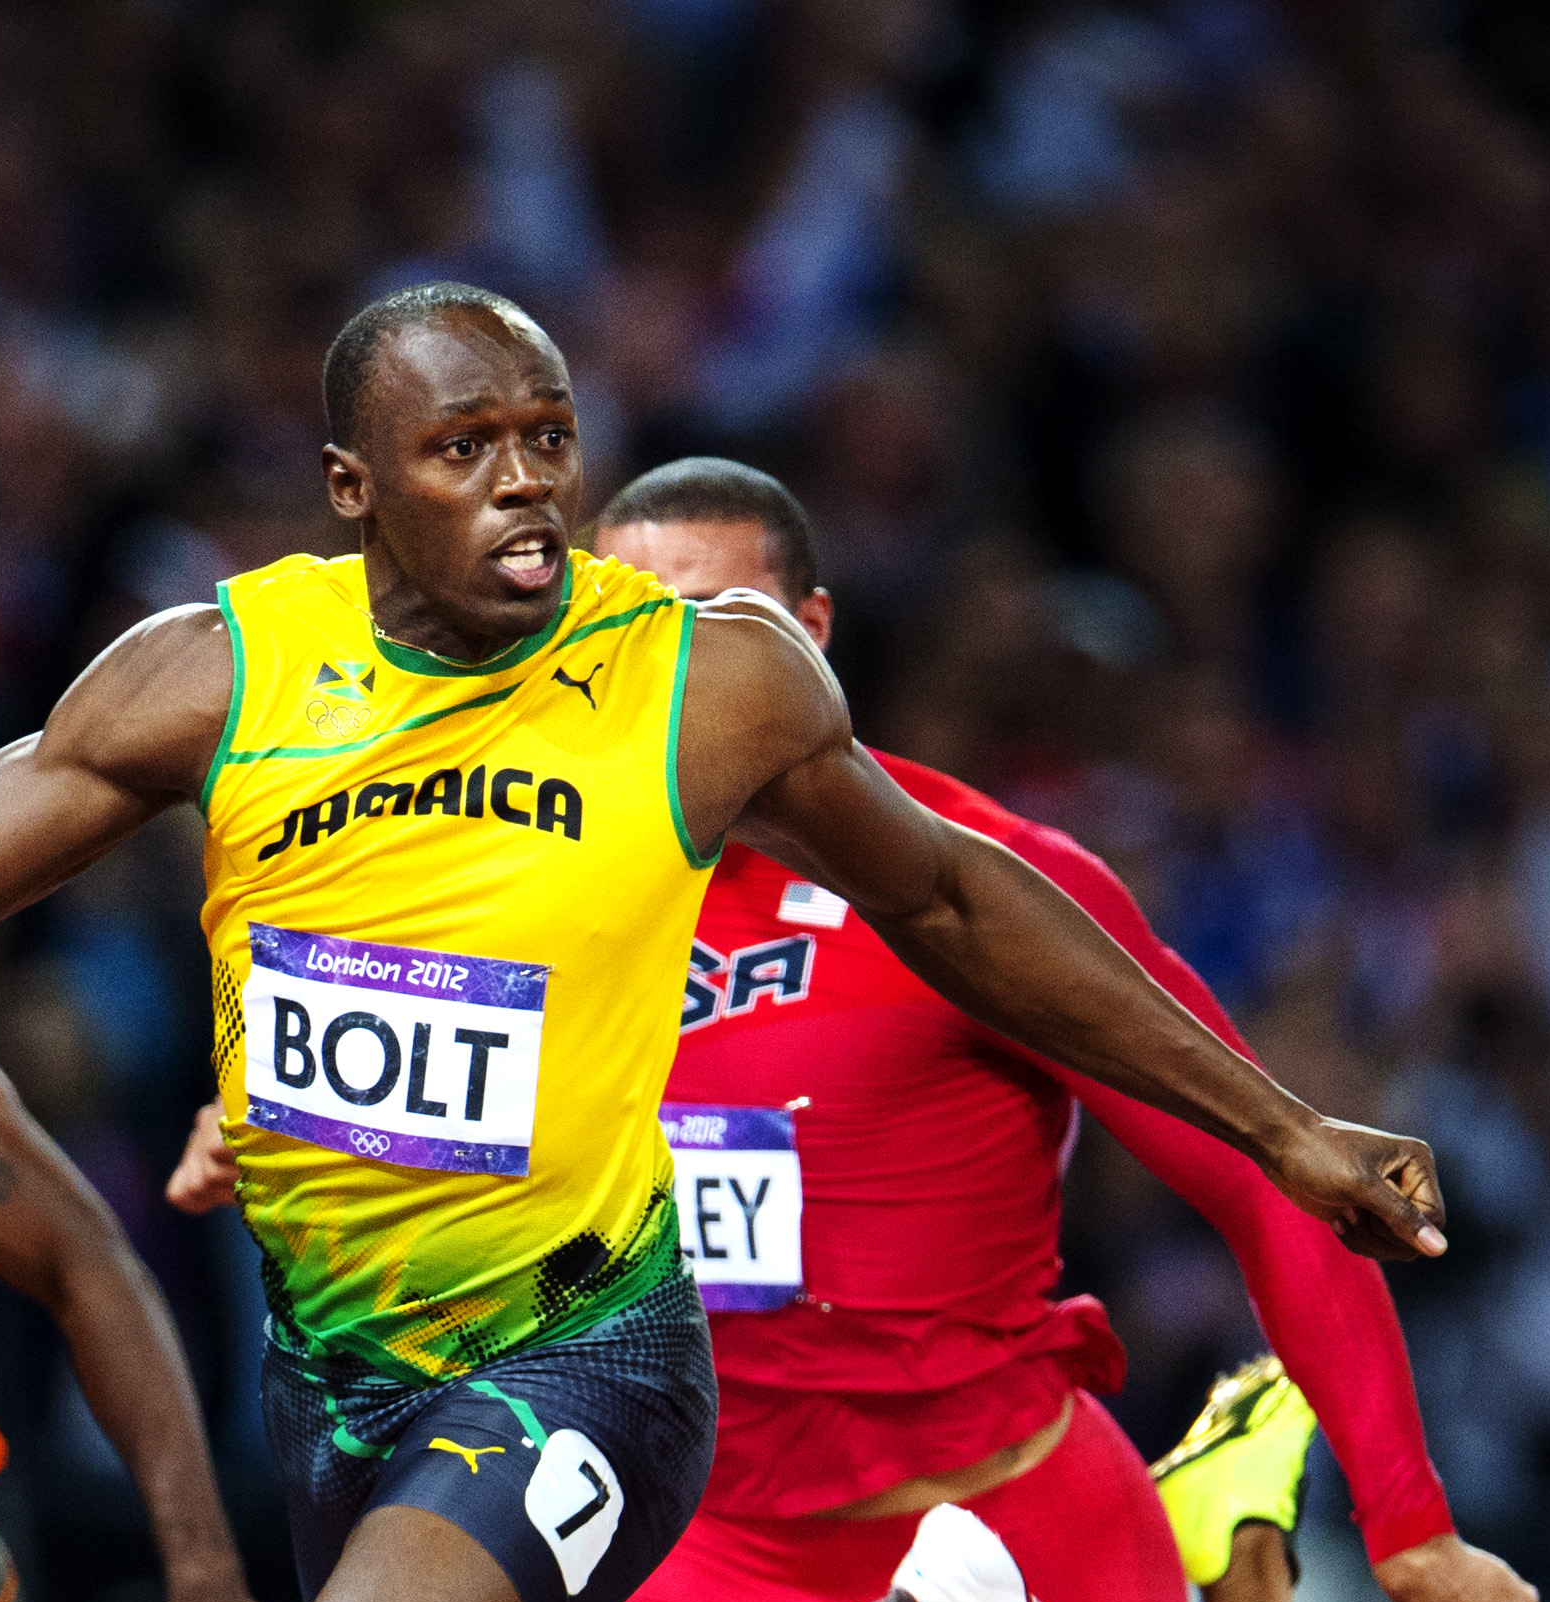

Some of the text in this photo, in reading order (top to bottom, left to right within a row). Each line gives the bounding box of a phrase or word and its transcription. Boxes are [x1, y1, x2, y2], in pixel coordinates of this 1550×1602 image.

[258, 763, 583, 862] JAMAICA
[306, 943, 469, 992] London 2012
[679, 932, 816, 1035] SA
[273, 996, 509, 1121] BOLT
[555, 1459, 610, 1541] 7
